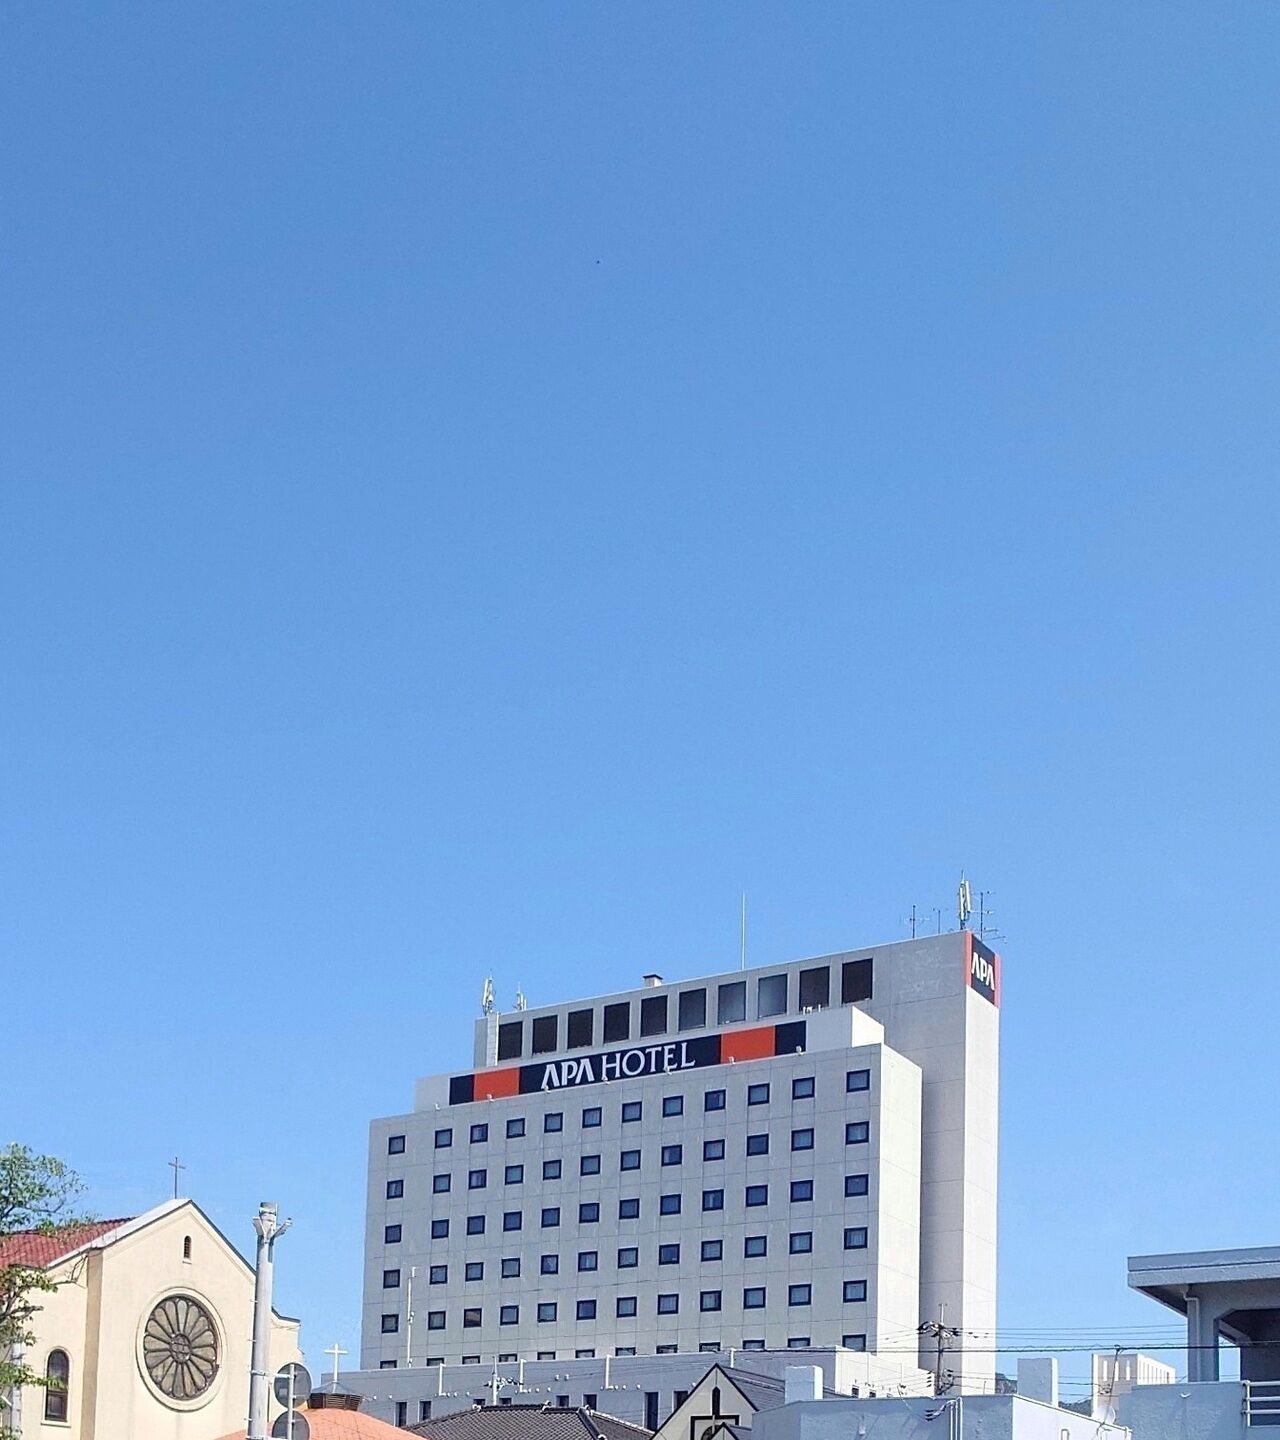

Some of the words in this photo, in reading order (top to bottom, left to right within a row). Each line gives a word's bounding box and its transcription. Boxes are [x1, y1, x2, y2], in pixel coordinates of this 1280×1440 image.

[971, 951, 996, 991] APA
[541, 1058, 595, 1089] APA
[602, 1042, 696, 1079] HOTEL
